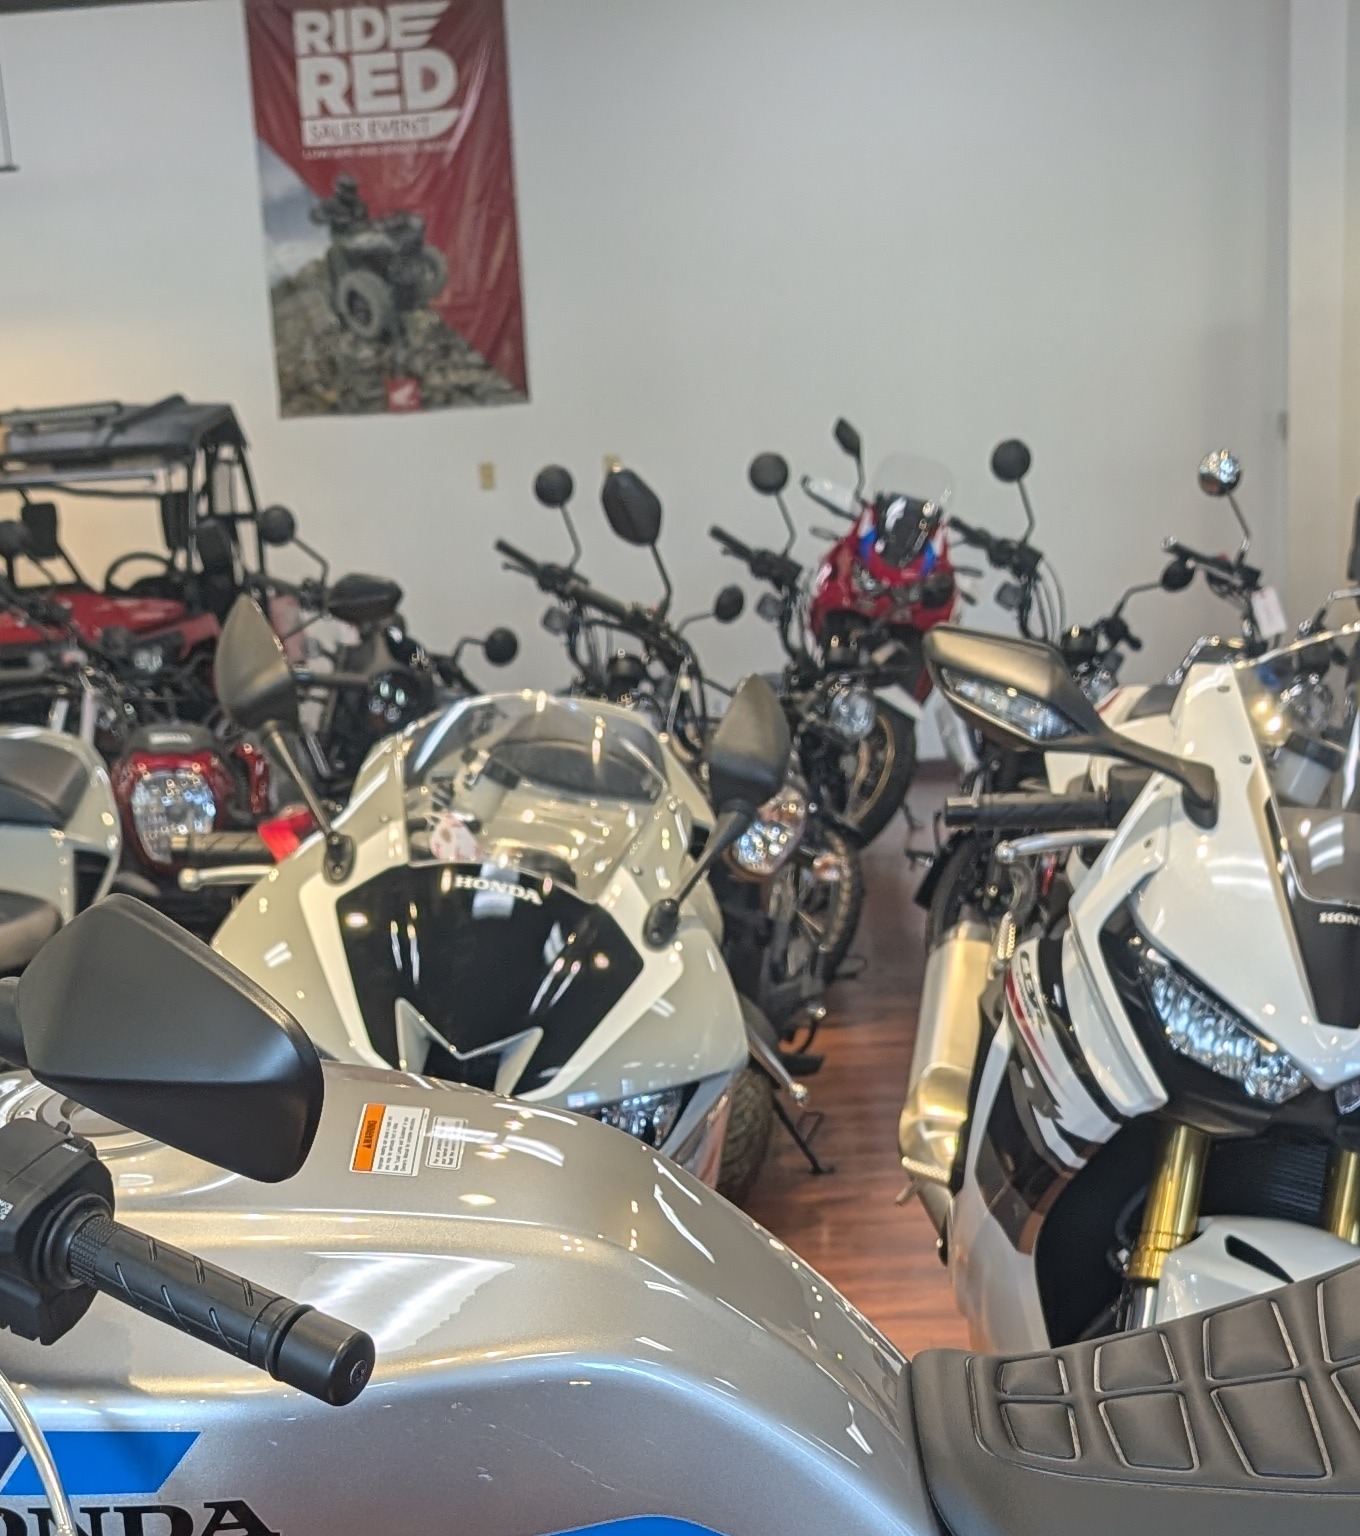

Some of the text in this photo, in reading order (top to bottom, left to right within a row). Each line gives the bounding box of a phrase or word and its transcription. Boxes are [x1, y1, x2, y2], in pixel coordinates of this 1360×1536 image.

[293, 1, 452, 56] RIDE
[296, 47, 459, 118] RED
[309, 115, 430, 143] SALES EVENT
[454, 874, 544, 906] HONDA
